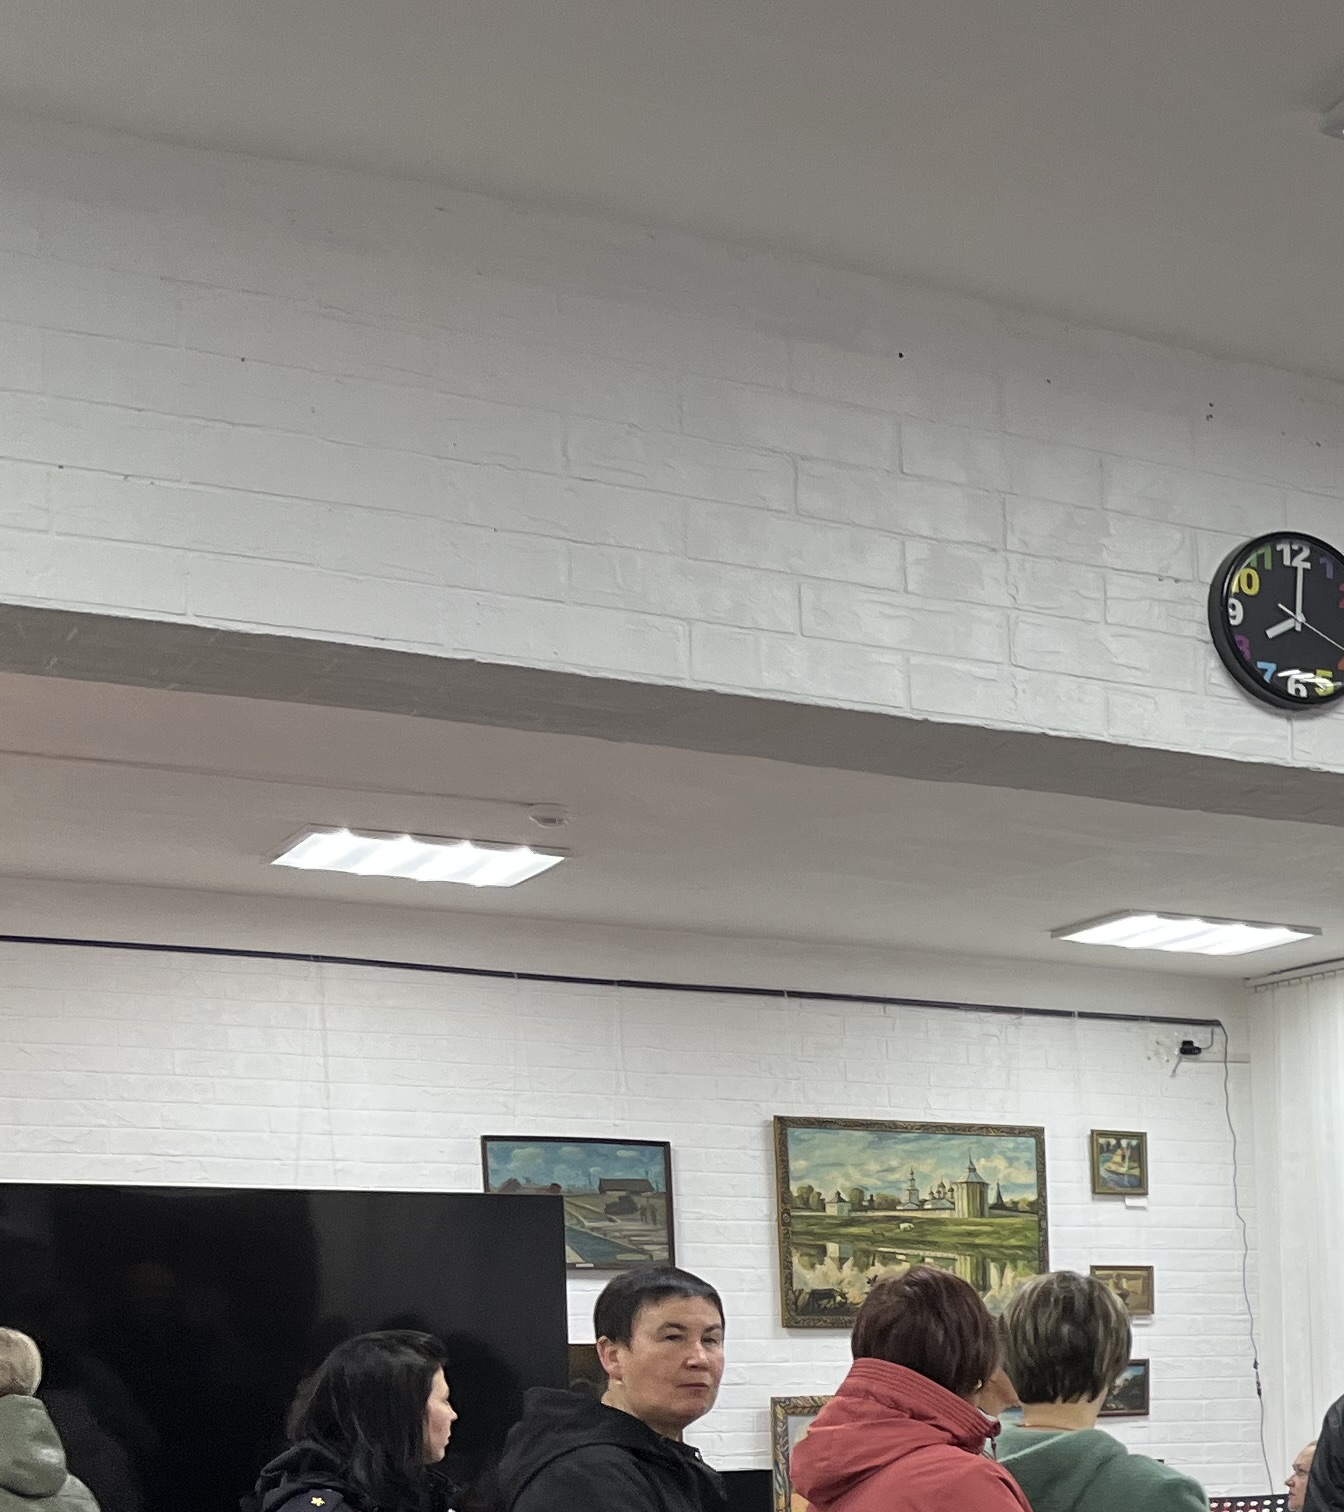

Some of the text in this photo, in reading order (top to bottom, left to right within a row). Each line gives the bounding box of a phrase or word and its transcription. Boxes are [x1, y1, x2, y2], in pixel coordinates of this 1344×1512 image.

[1276, 541, 1311, 570] 12
[1319, 555, 1334, 579] 1
[1231, 567, 1260, 595] 10
[1228, 598, 1244, 626] 9
[1256, 661, 1277, 684] 7
